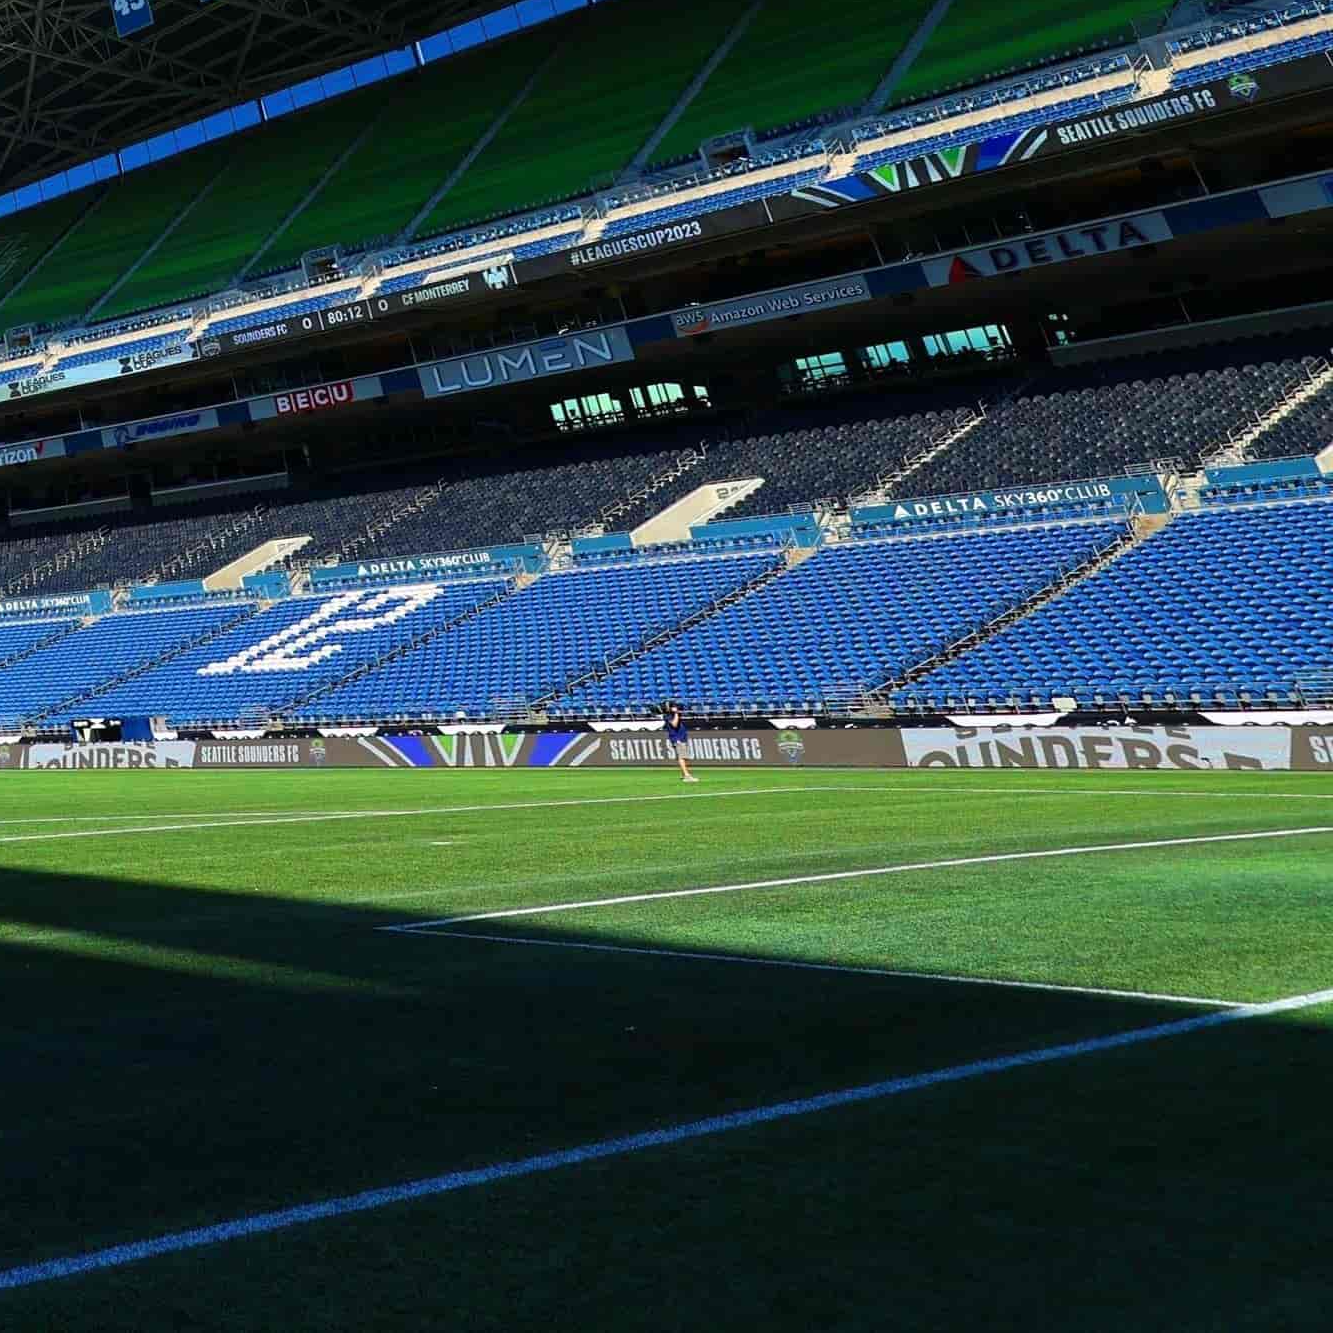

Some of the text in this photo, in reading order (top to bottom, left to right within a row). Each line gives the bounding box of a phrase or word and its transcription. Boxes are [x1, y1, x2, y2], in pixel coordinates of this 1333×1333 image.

[1057, 89, 1216, 145] SEATTLE SOUNDERS FC
[570, 221, 702, 266] #LEAGUESCUP2023
[990, 221, 1149, 272] DELTA
[232, 278, 471, 346] SOUNDERS FC 0 80:12 0 CF MONTERREY
[709, 301, 765, 324] Amazon
[767, 296, 800, 312] Web
[803, 283, 863, 306] Services
[133, 345, 182, 364] LEAGUES
[434, 333, 615, 393] LUMEN
[915, 496, 988, 517] DELTA
[370, 561, 416, 574] DELTA
[5, 600, 38, 611] DELTA
[201, 745, 299, 763] SEATTLE SOUNDERS FC
[610, 738, 762, 760] SEATTLE SUNDERS FC
